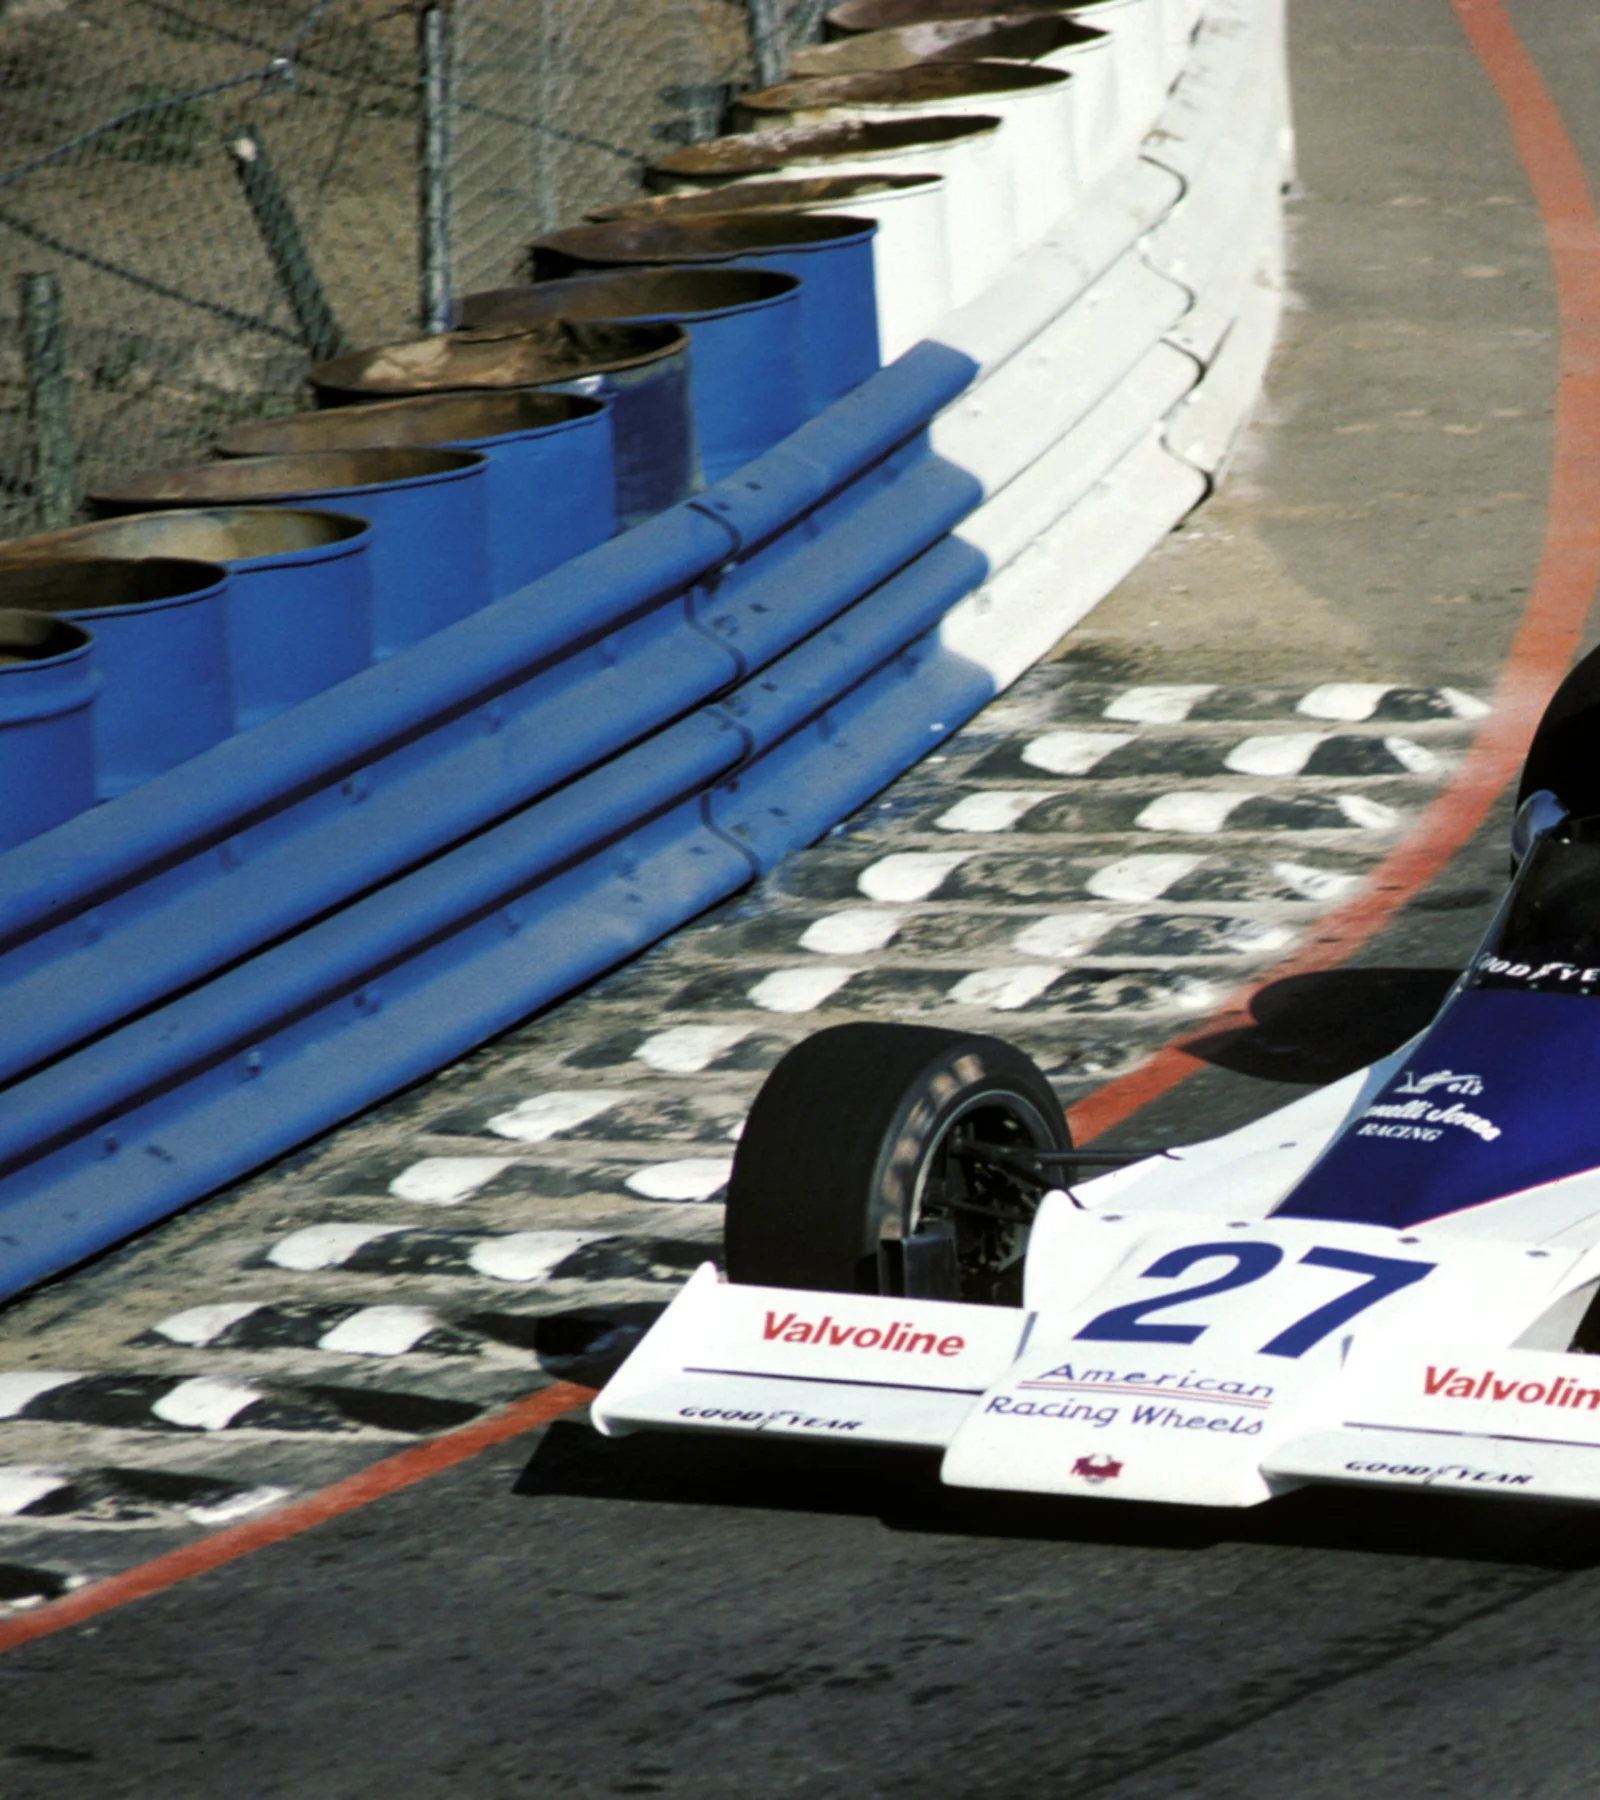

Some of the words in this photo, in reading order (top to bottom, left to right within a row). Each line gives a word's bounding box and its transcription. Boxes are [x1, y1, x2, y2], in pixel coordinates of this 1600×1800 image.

[1356, 1122, 1444, 1142] RACING
[1071, 1241, 1439, 1359] 27
[761, 1310, 966, 1358] Valvoline
[1036, 1362, 1275, 1399] American
[984, 1395, 1120, 1428] Racing
[1131, 1403, 1265, 1436] Wheels
